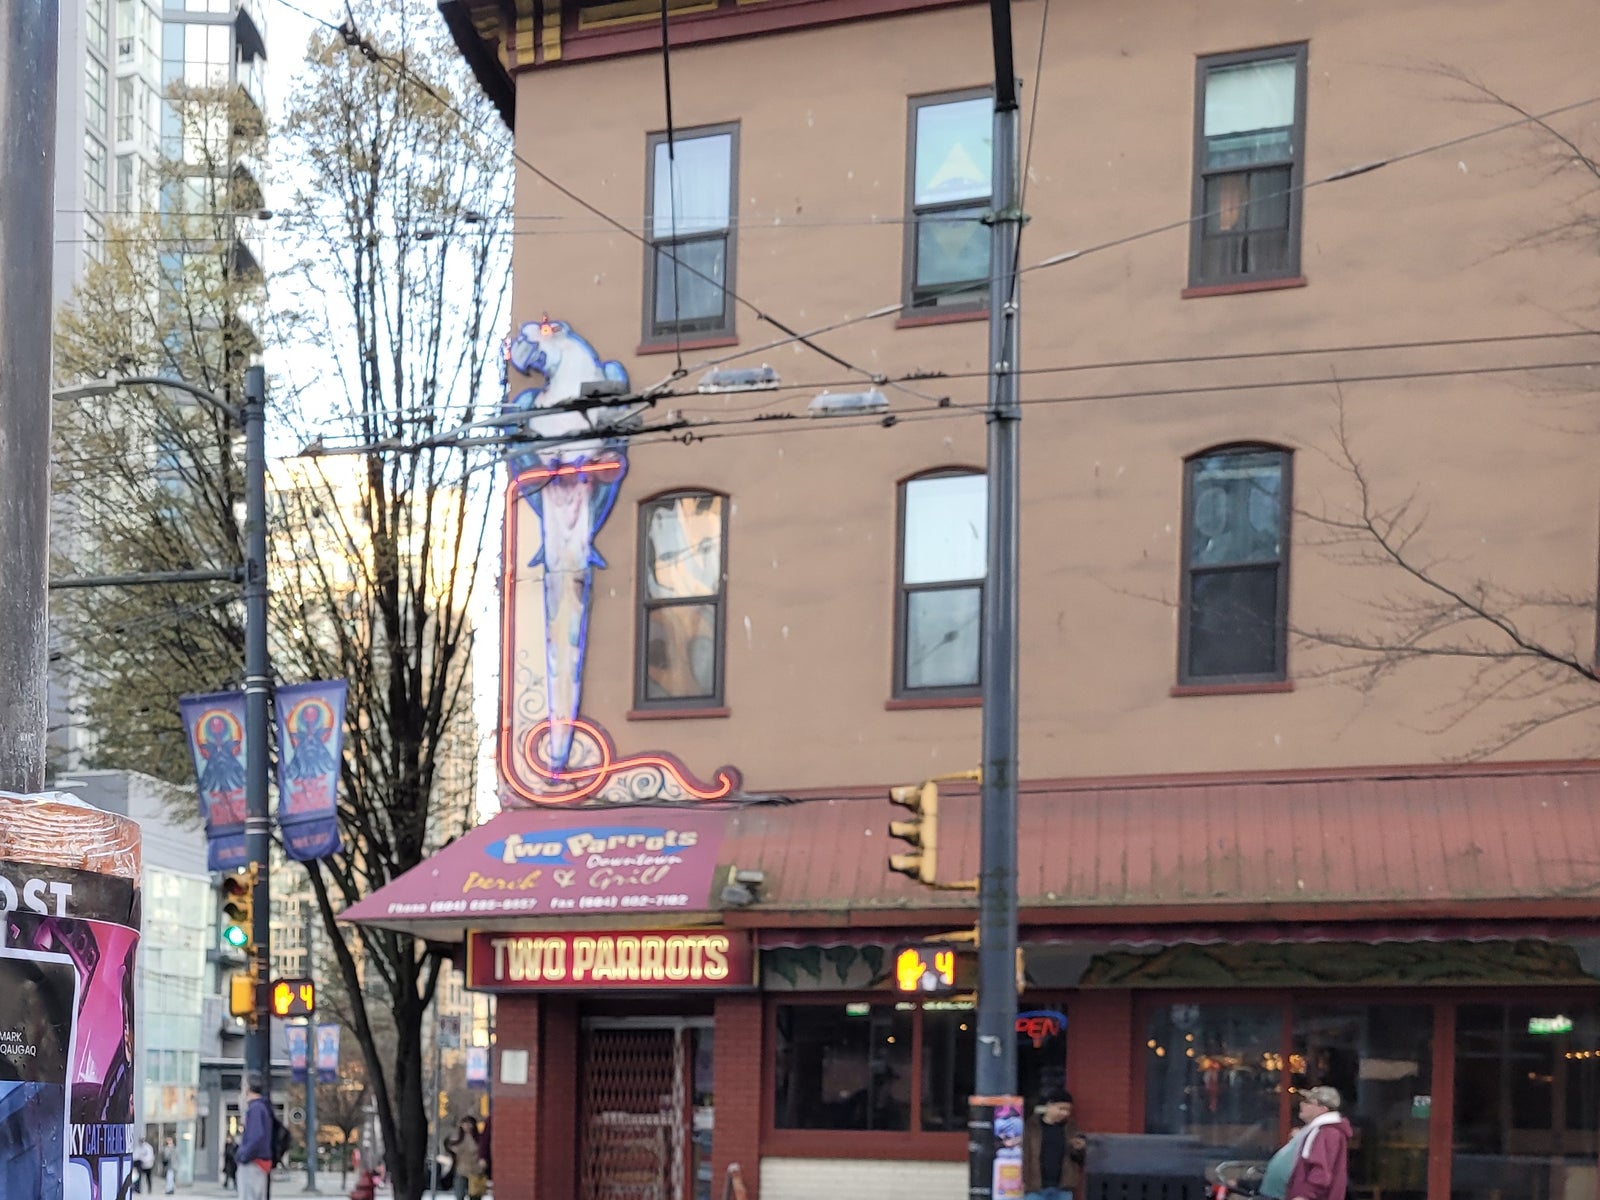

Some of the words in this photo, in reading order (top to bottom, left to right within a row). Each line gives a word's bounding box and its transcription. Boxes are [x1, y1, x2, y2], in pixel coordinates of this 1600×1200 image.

[566, 828, 698, 857] Parrots
[587, 853, 683, 869] Downtown
[491, 937, 567, 981] TWO
[571, 934, 729, 981] PARROTS
[933, 950, 954, 985] 4
[300, 984, 313, 1011] 4
[1015, 1017, 1060, 1040] PEN
